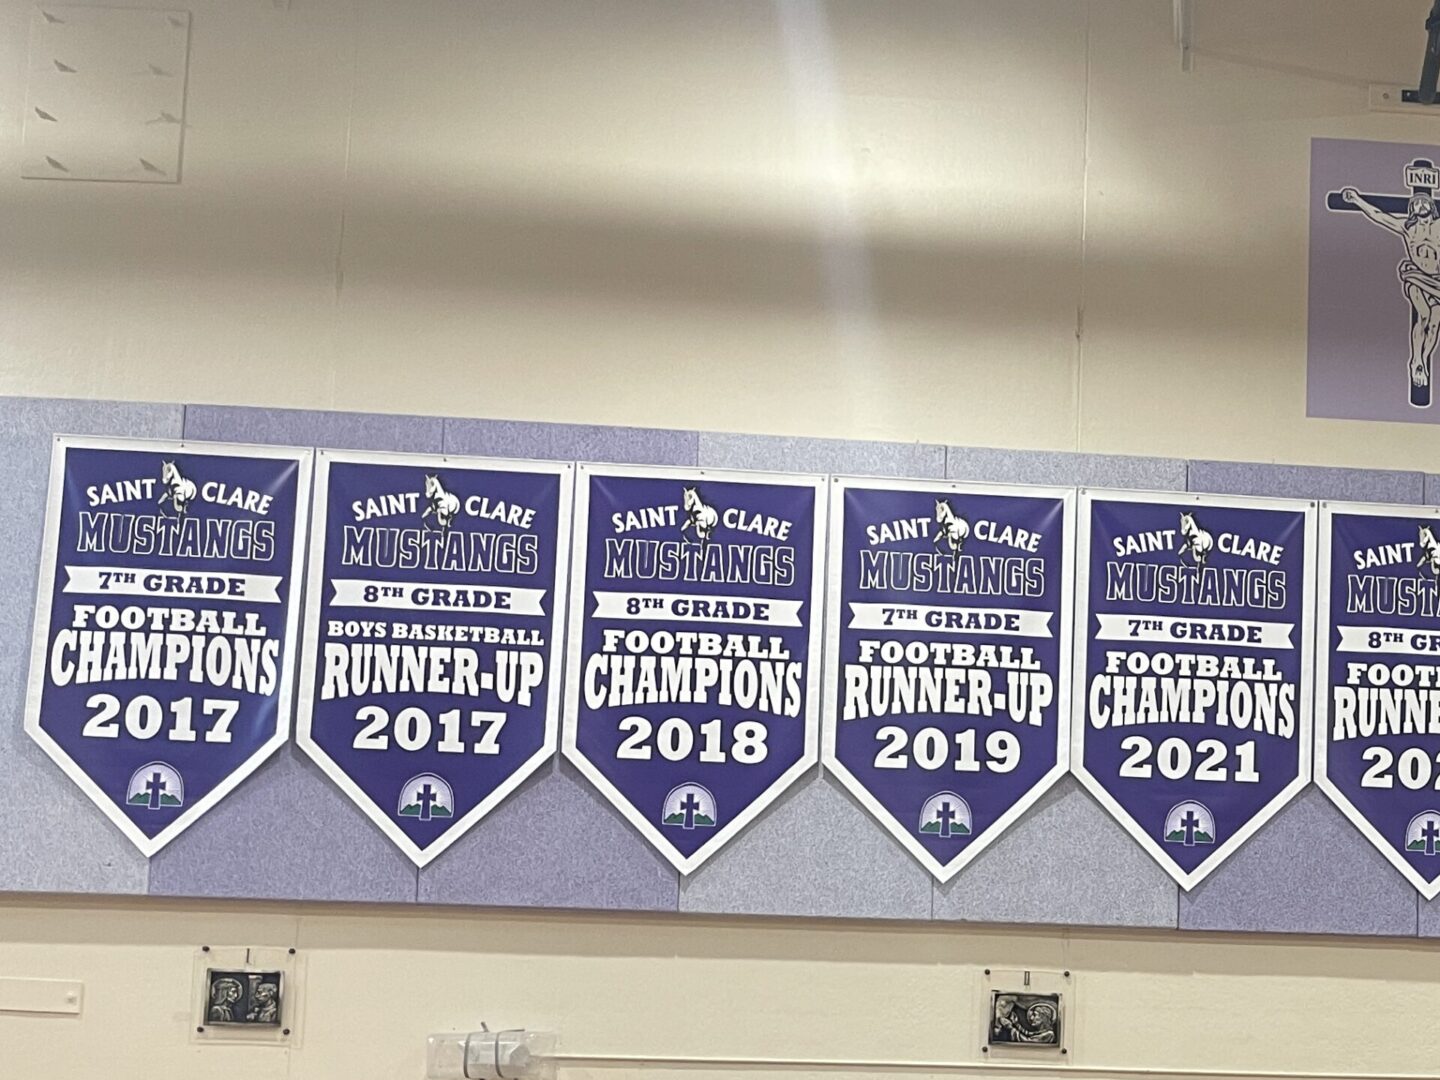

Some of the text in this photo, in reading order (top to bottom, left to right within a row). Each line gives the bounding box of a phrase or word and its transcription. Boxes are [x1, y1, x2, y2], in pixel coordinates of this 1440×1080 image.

[1410, 173, 1435, 184] INRI
[87, 479, 273, 515] SAINT CLARE
[352, 493, 536, 529] SAINT CLARE
[77, 512, 275, 561] MUSTANGS
[611, 505, 792, 541] SAINT CLARE
[866, 517, 1041, 553] SAINT CLARE
[342, 526, 538, 574] MUSTANGS
[604, 539, 795, 587] MUSTANGS
[1113, 530, 1283, 565] SAINT CLARE
[1353, 543, 1415, 570] SAINT
[98, 571, 245, 597] 7TH GRADE
[859, 550, 1045, 597] MUSTANGS
[1106, 562, 1286, 609] MUSTANGS
[363, 585, 511, 609] 8TH GRADE
[626, 597, 770, 621] 8TH GRADE
[72, 604, 266, 636] FOOTBALL
[328, 620, 544, 646] BOYS BASKETBALL
[882, 609, 1020, 631] 7TH GRADE
[1128, 620, 1262, 643] 7TH GRADE
[603, 629, 790, 660] FOOTBALL
[858, 640, 1040, 671] FOOTBALL
[1368, 632, 1404, 650] 8TH
[50, 630, 279, 696] CHAMPIONS
[321, 642, 544, 707] RUNNER-UP
[1106, 651, 1282, 681] FOOTBALL
[584, 653, 802, 719] CHAMPIONS
[843, 663, 1053, 727] RUNNER-UP
[82, 693, 239, 743] 2017
[1089, 674, 1295, 739] CHAMPIONS
[353, 706, 507, 754] 2017
[616, 716, 768, 764] 2018
[874, 726, 1020, 773] 2019
[1119, 736, 1260, 783] 2021
